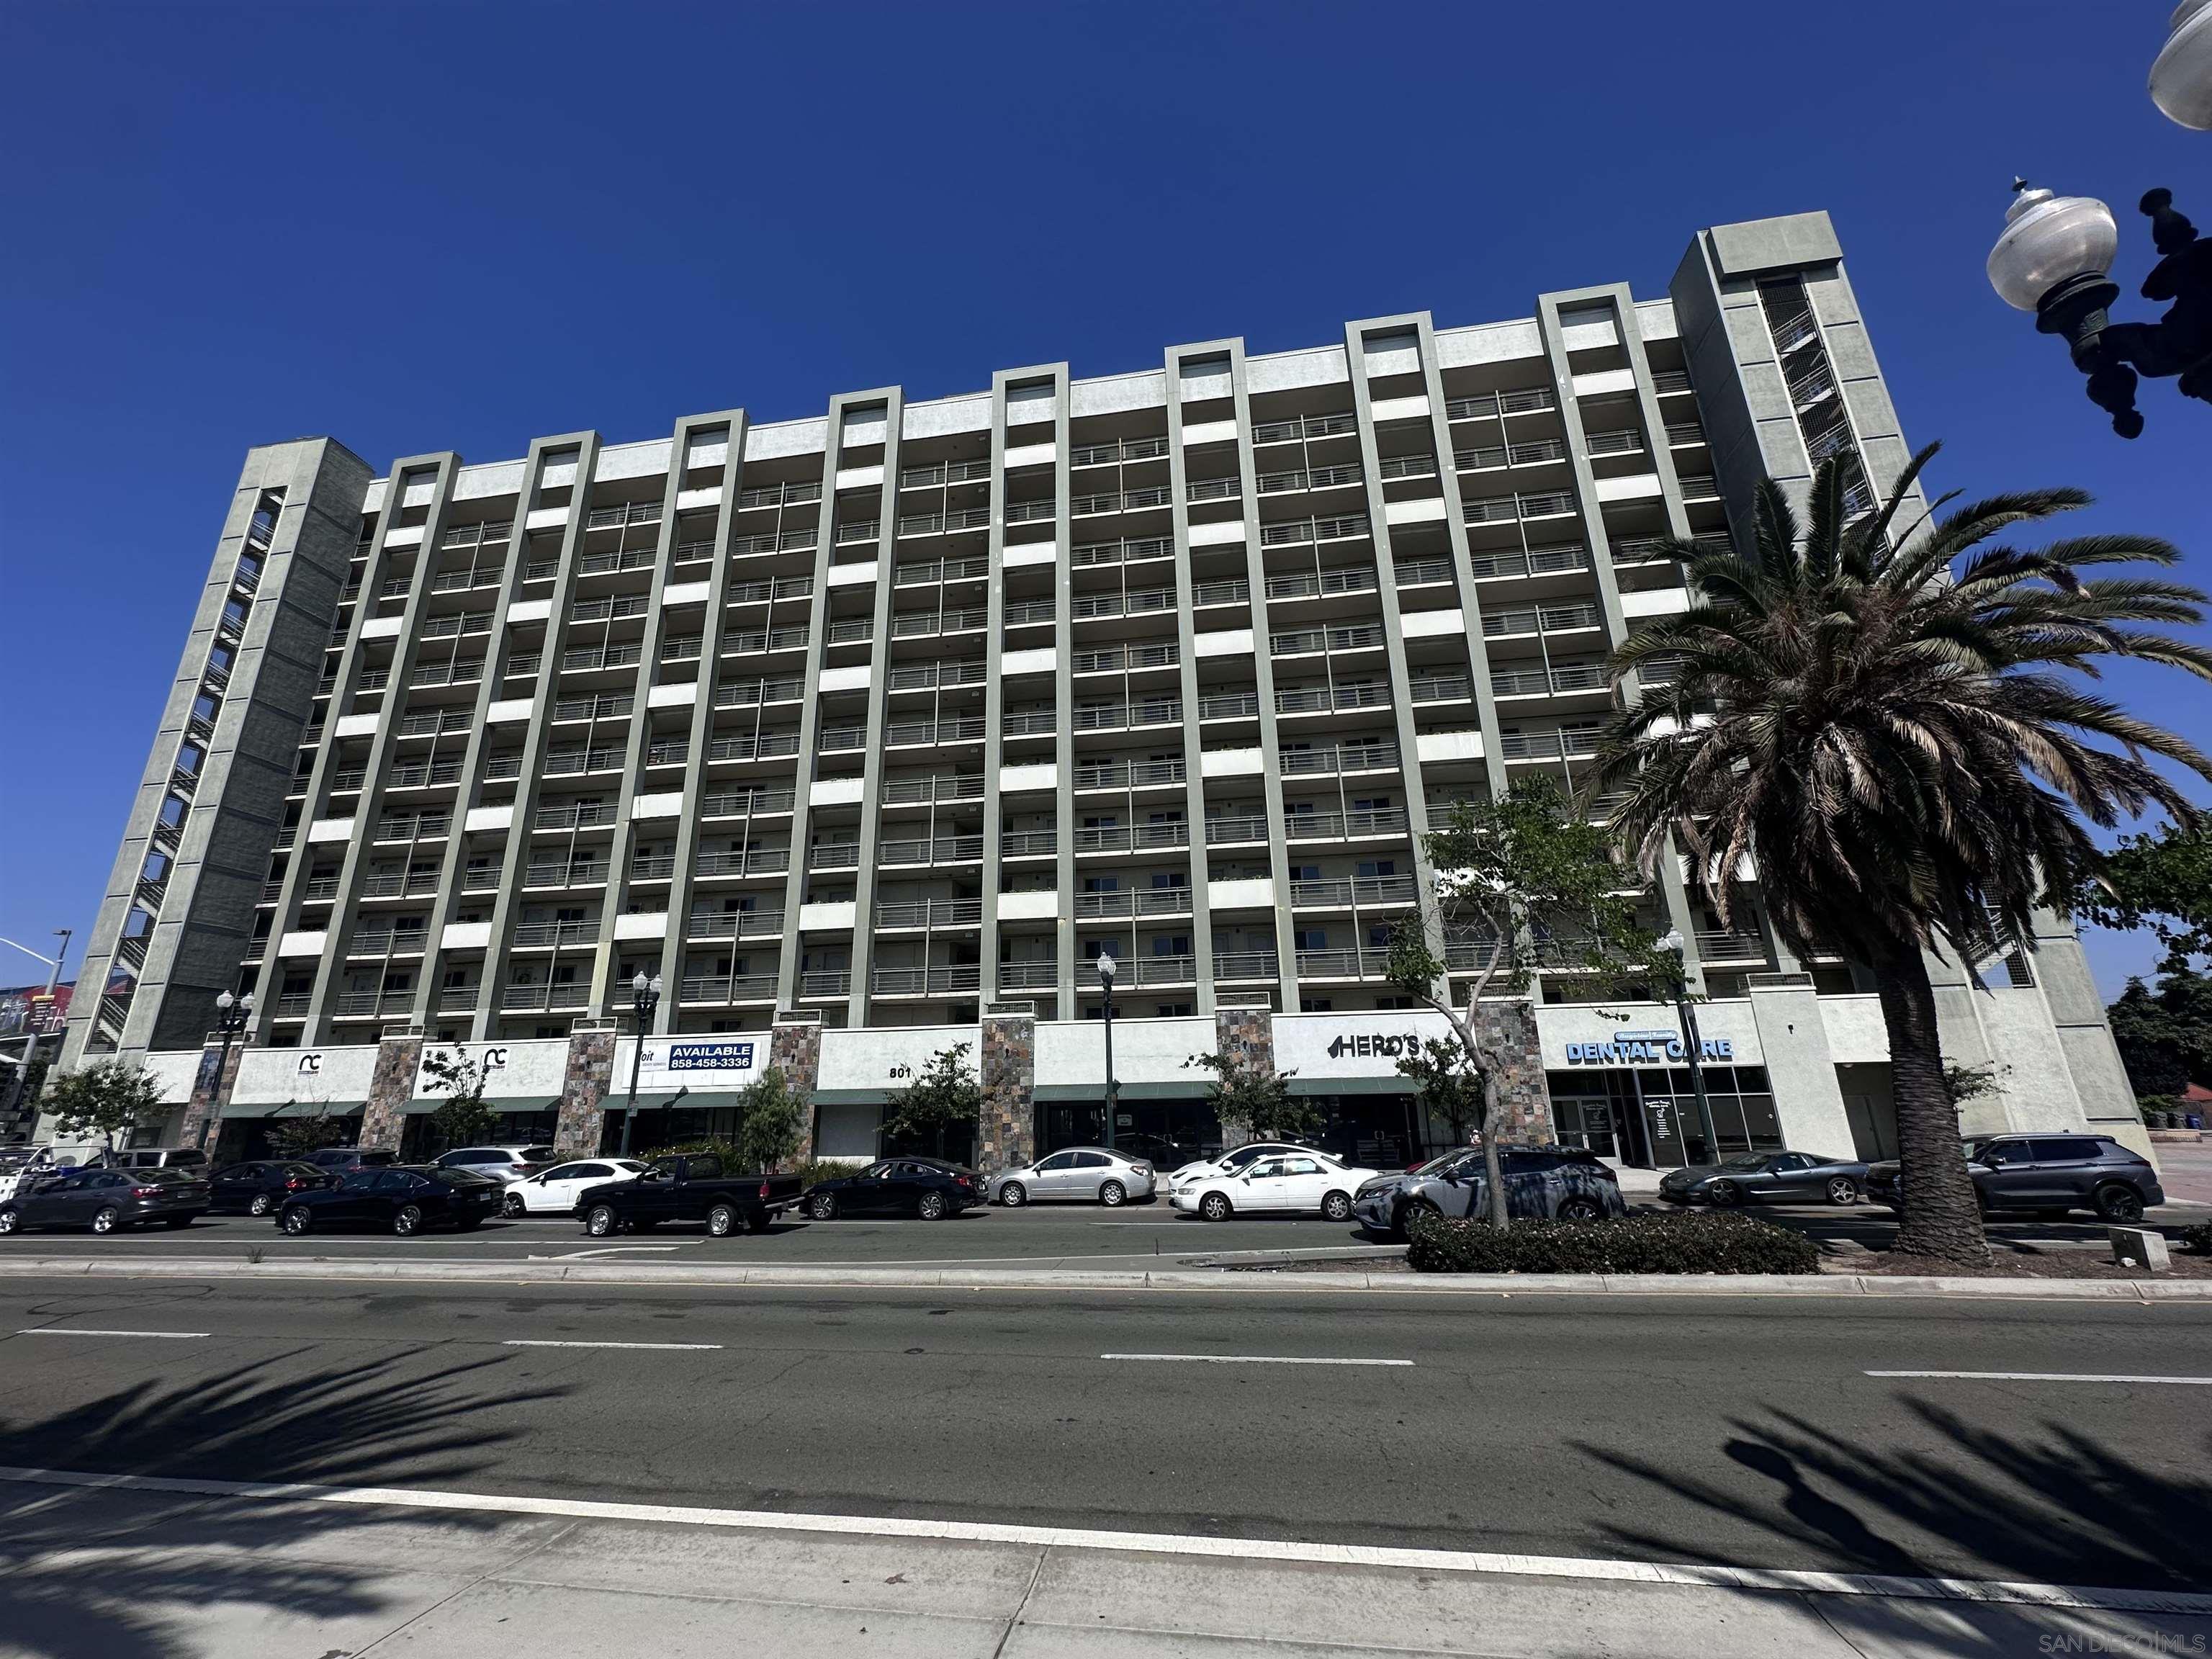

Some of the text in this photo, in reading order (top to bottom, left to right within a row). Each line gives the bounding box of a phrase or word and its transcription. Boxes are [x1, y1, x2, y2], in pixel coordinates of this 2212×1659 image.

[672, 1046, 751, 1057] AVAILABLE
[1566, 1038, 1735, 1061] DENTAL CRE
[671, 1057, 750, 1069] 858-458-3336
[890, 1067, 911, 1078] 801
